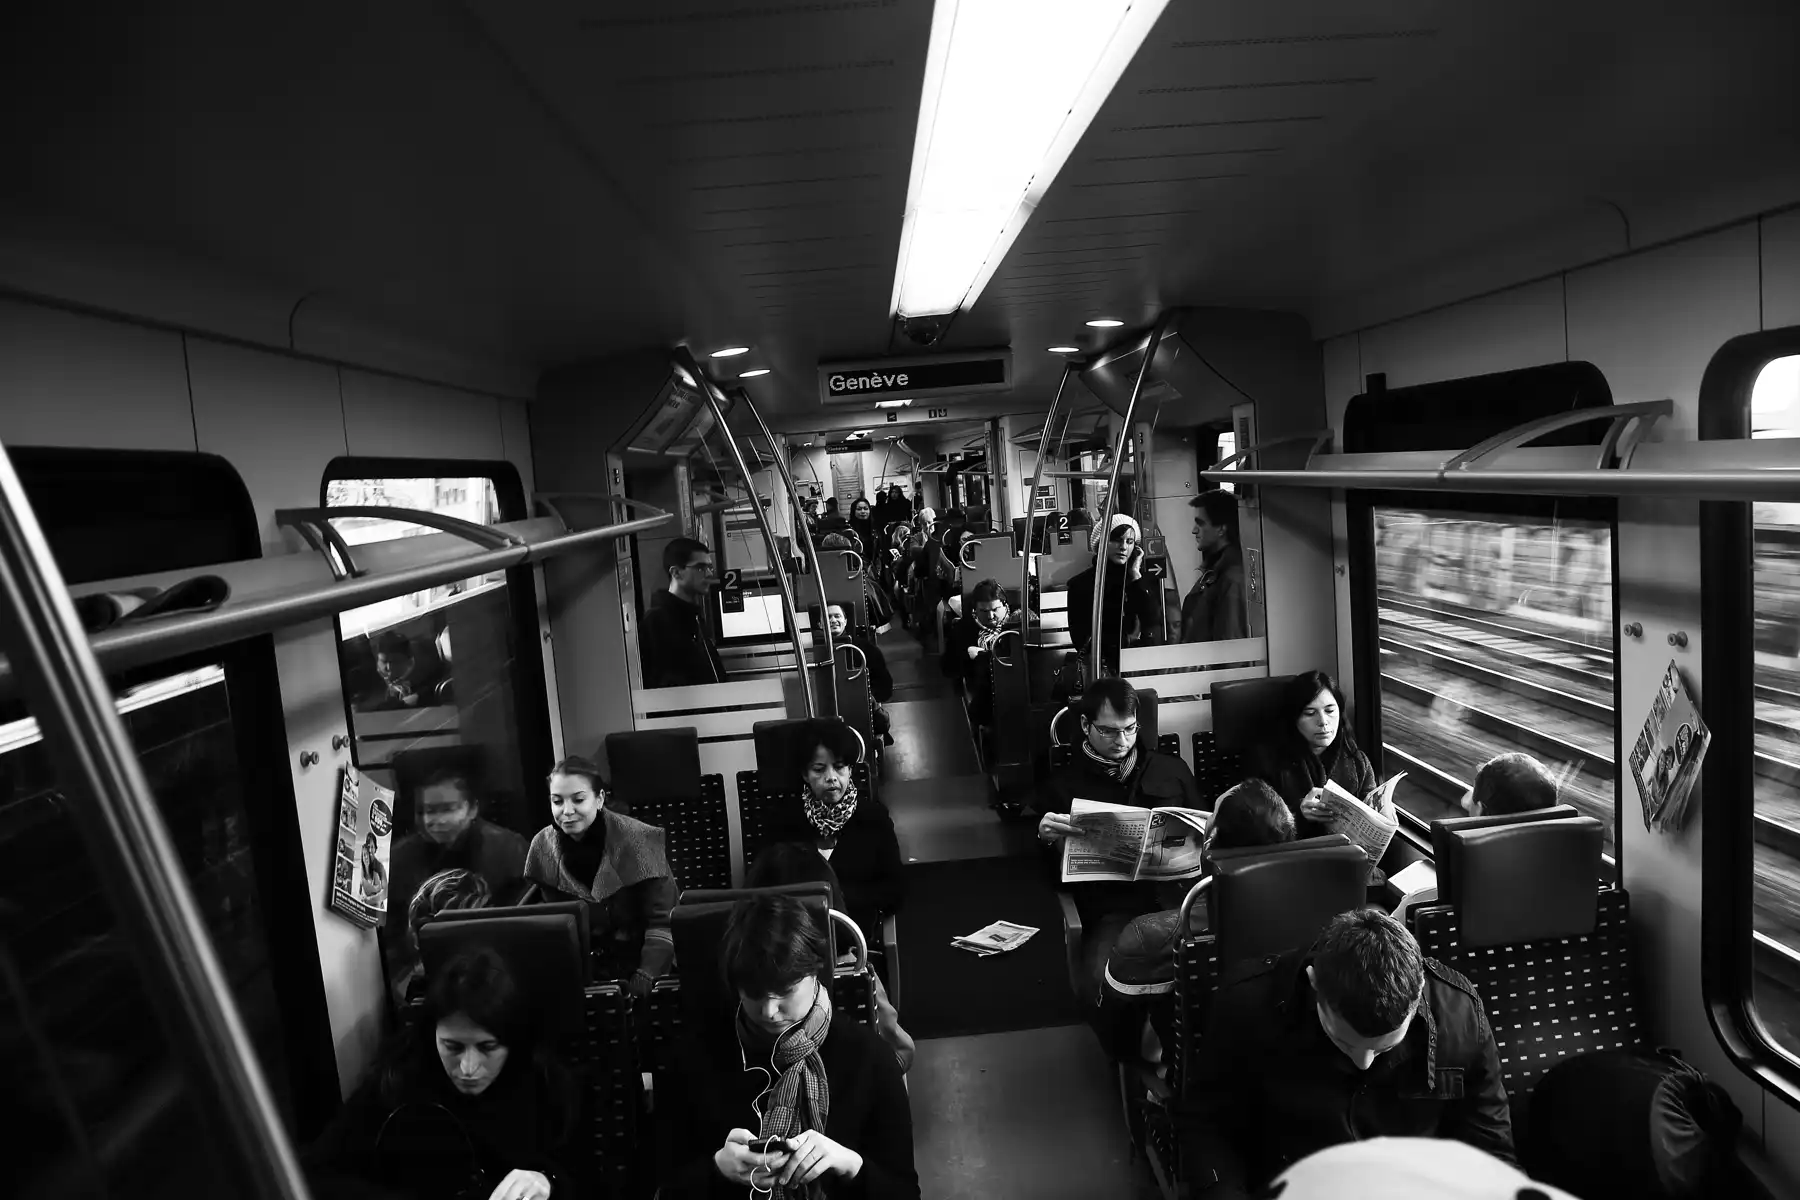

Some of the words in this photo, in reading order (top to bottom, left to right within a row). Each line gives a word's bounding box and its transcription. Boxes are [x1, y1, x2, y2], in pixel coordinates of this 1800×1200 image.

[829, 372, 909, 392] Genève
[1059, 516, 1069, 530] 2
[724, 571, 738, 590] 2
